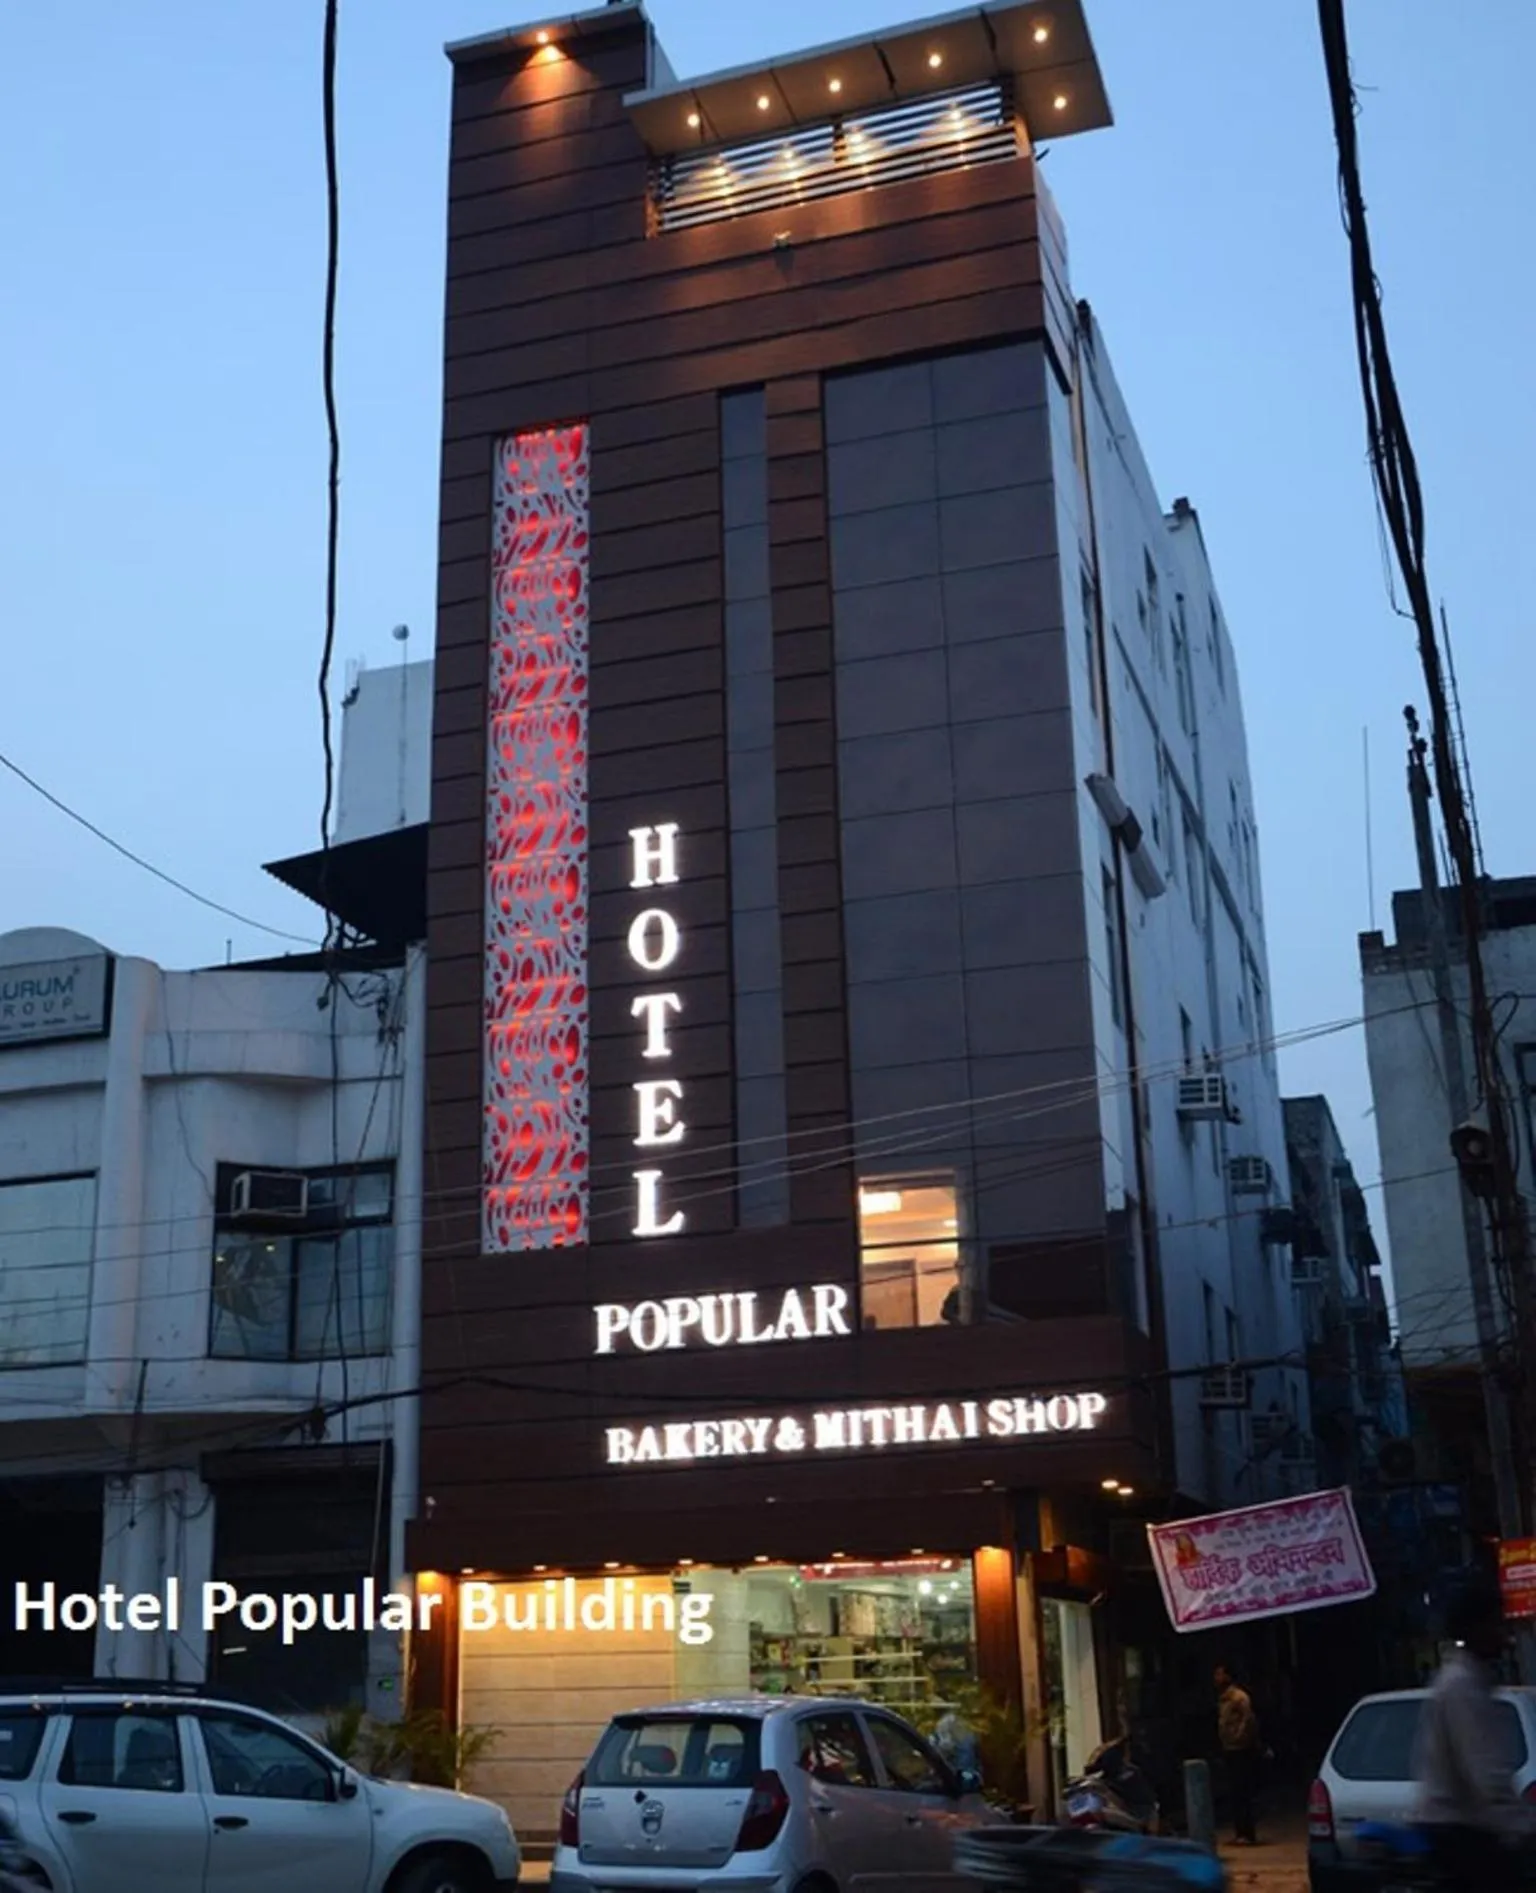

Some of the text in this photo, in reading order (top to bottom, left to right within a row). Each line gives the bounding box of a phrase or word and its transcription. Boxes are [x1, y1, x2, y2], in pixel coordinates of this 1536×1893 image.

[627, 822, 686, 1237] HOTEL
[593, 1283, 851, 1355] POPULAR
[605, 1415, 773, 1465] BAKERY
[813, 1400, 979, 1451] MITHAI
[987, 1391, 1107, 1437] SHOP
